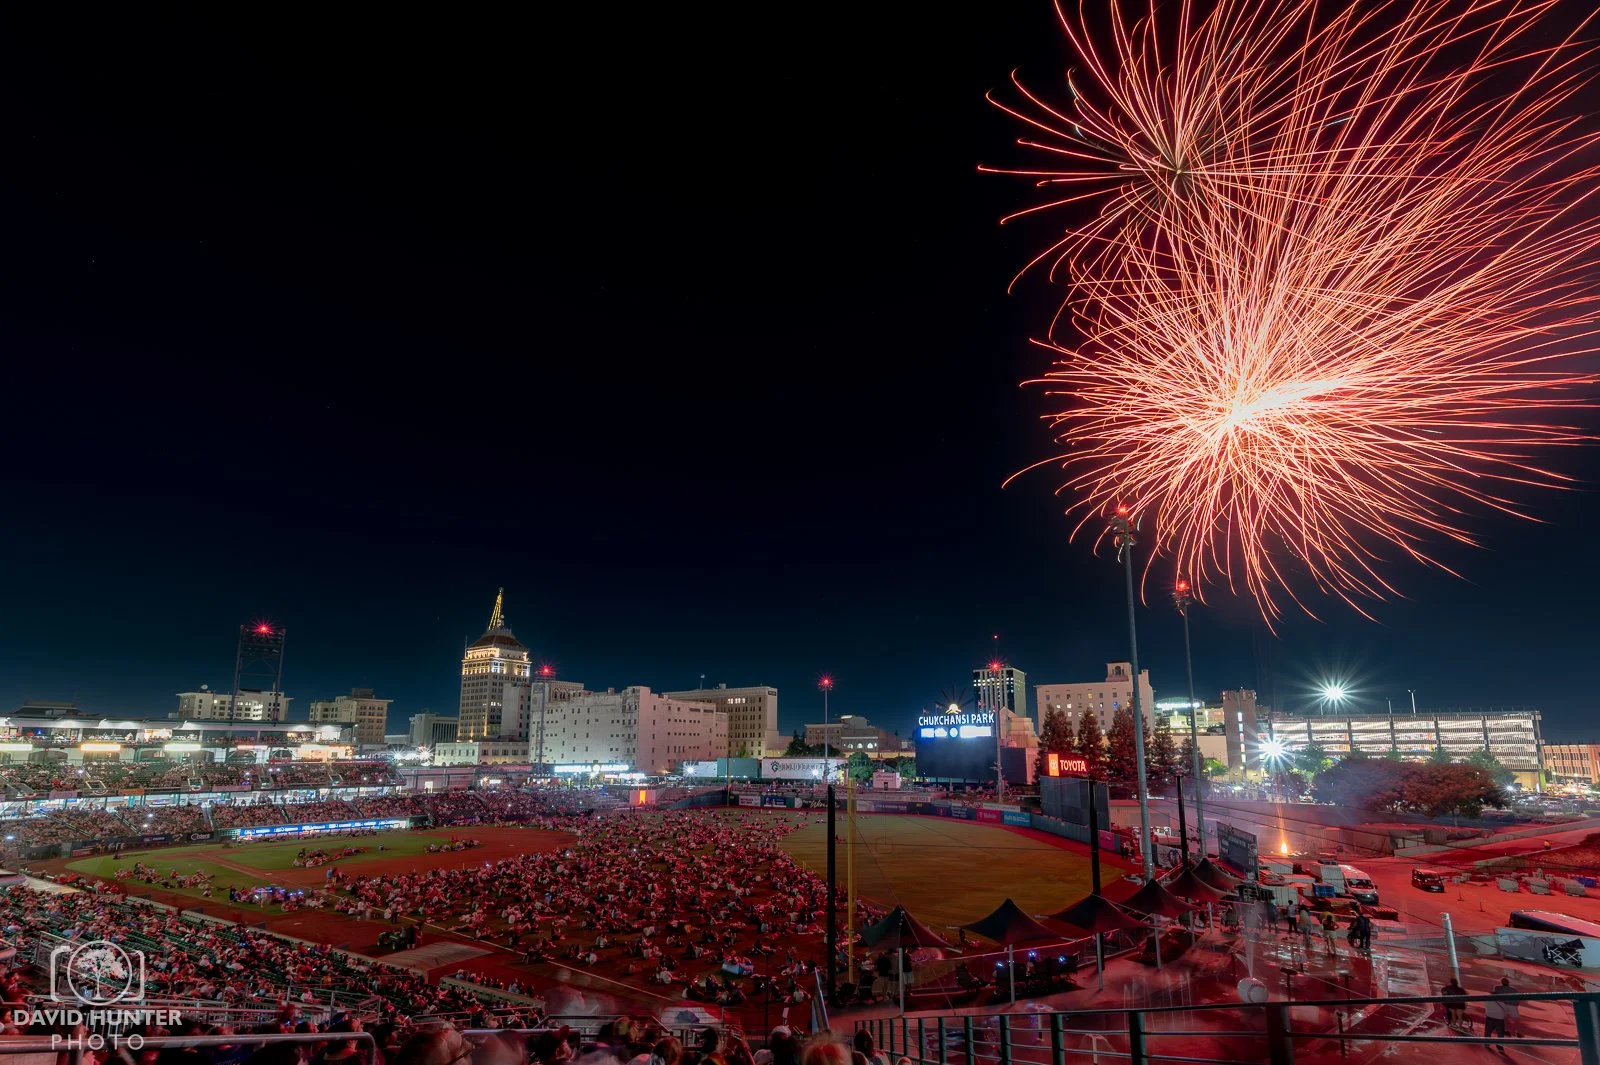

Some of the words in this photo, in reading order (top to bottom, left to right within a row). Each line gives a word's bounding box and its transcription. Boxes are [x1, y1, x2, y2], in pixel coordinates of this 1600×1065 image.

[918, 714, 969, 726] CHUKCHANSI
[971, 713, 995, 724] PARK
[1060, 759, 1087, 772] TOYOTA
